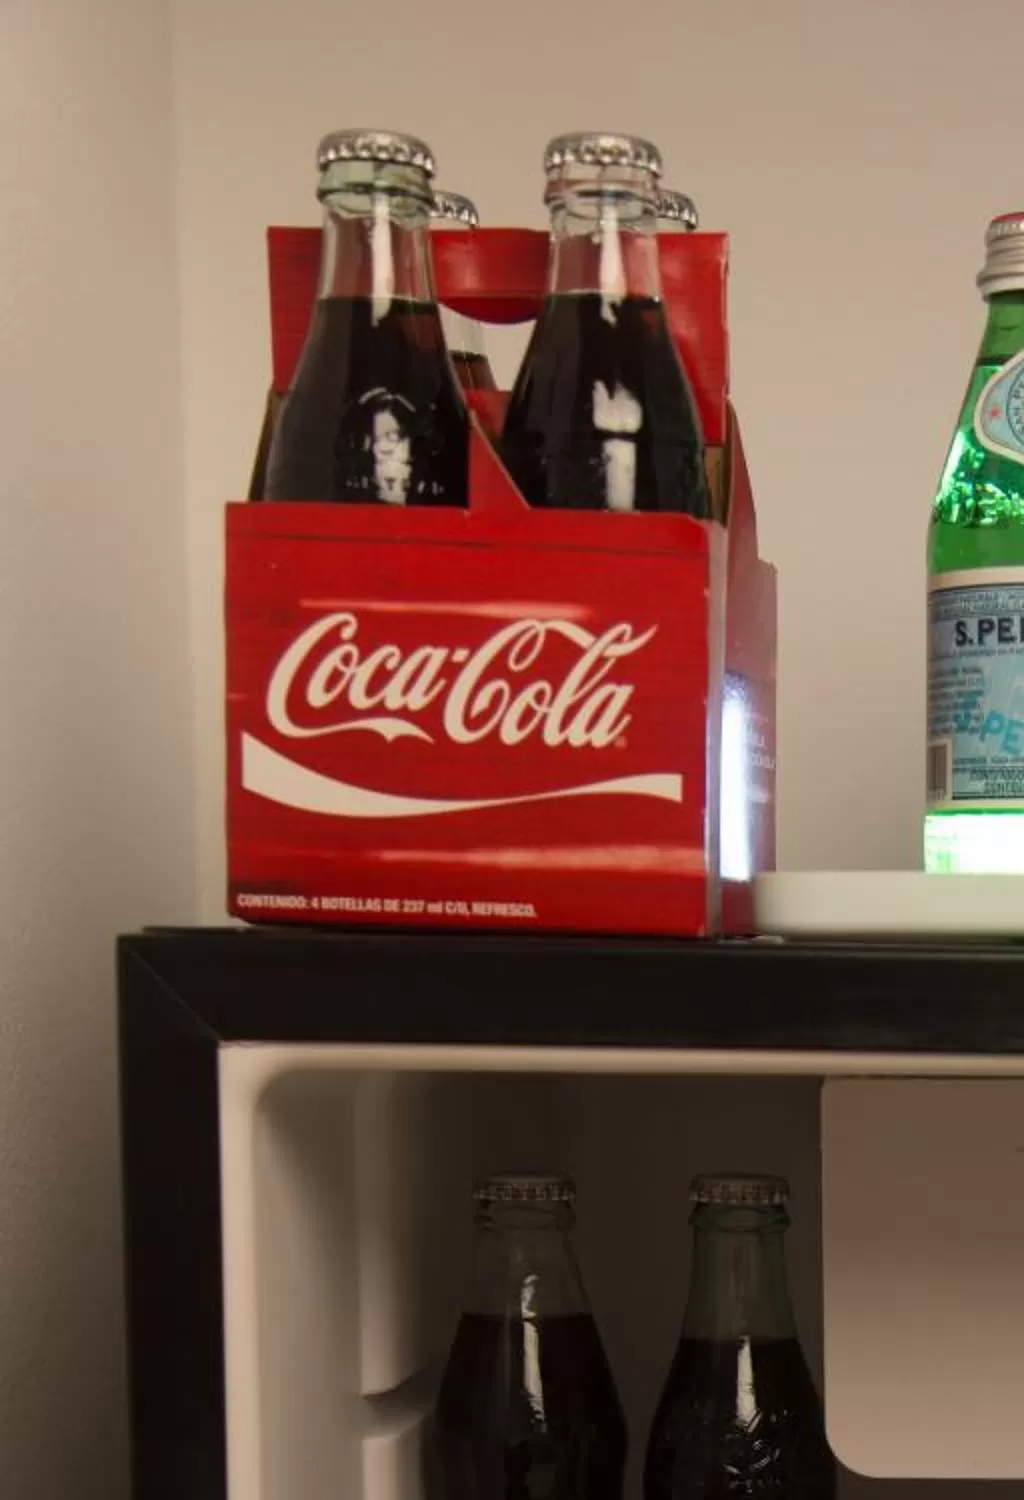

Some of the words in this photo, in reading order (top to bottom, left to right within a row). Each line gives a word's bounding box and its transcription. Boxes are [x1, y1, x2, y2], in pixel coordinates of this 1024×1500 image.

[266, 612, 658, 748] Coca-Cola
[311, 896, 320, 910] 4
[321, 896, 382, 912] BOTELLAS
[383, 898, 399, 912] DE
